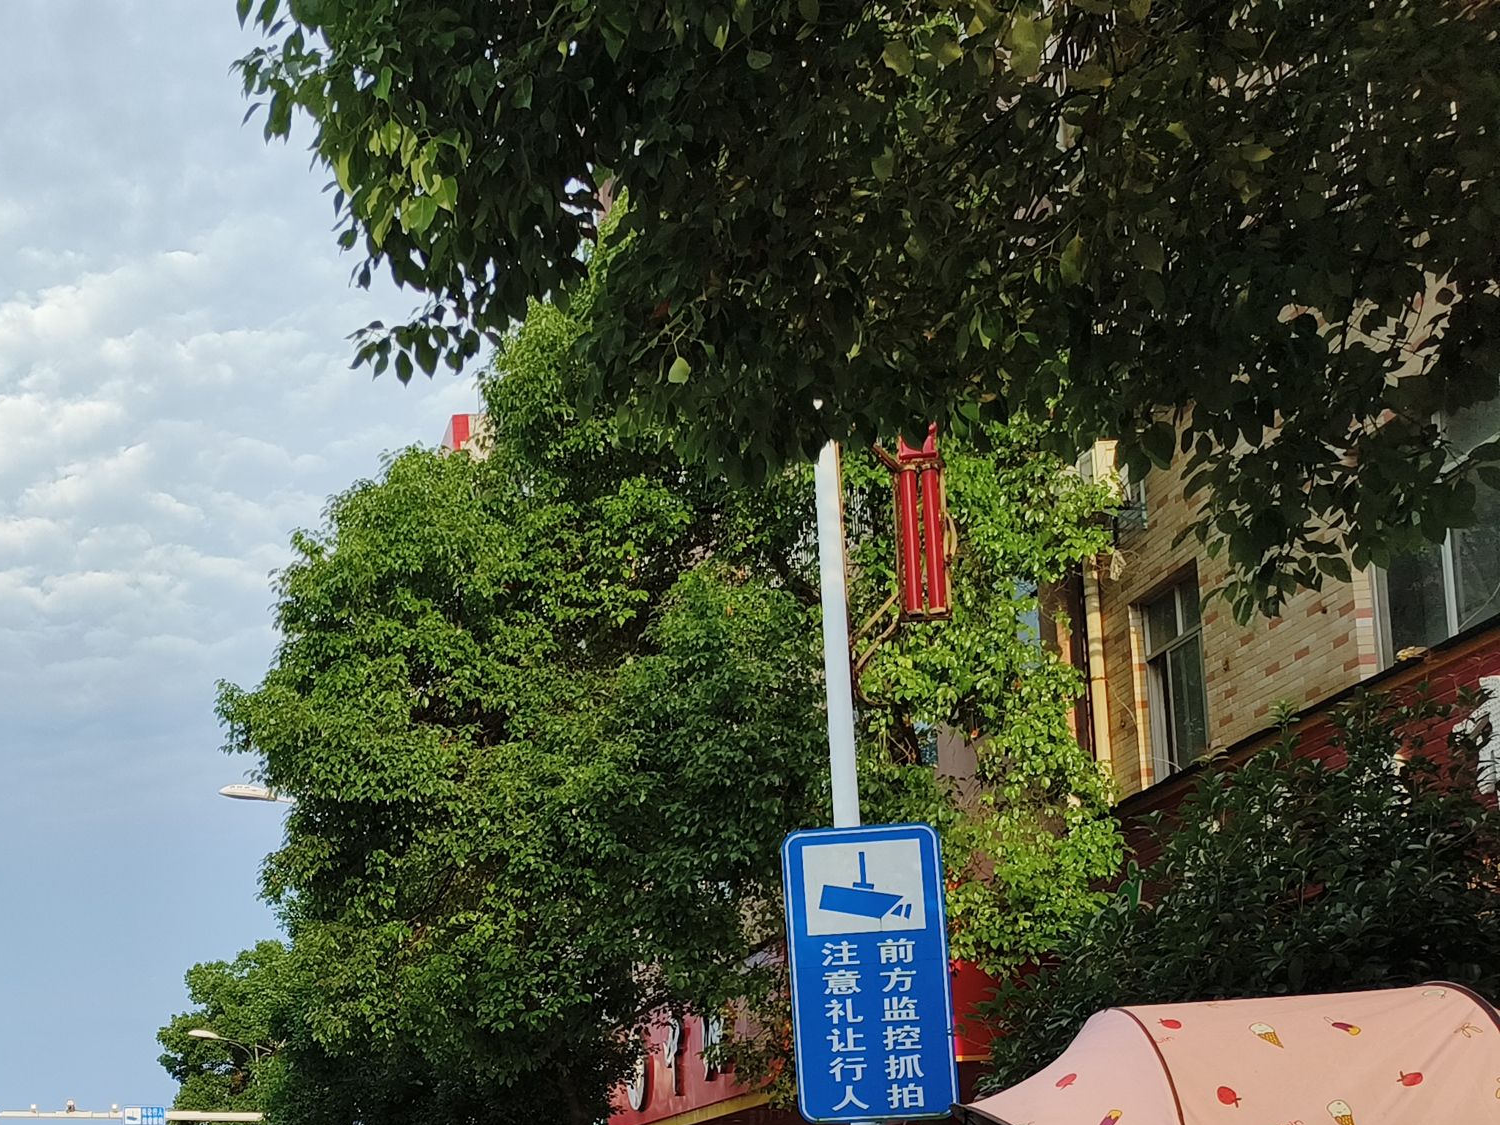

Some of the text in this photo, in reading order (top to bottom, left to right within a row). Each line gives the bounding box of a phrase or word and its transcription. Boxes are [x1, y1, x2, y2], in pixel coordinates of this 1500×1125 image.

[821, 940, 870, 1112] 注意礼让行人
[877, 937, 925, 1109] 前方监控抓拍
